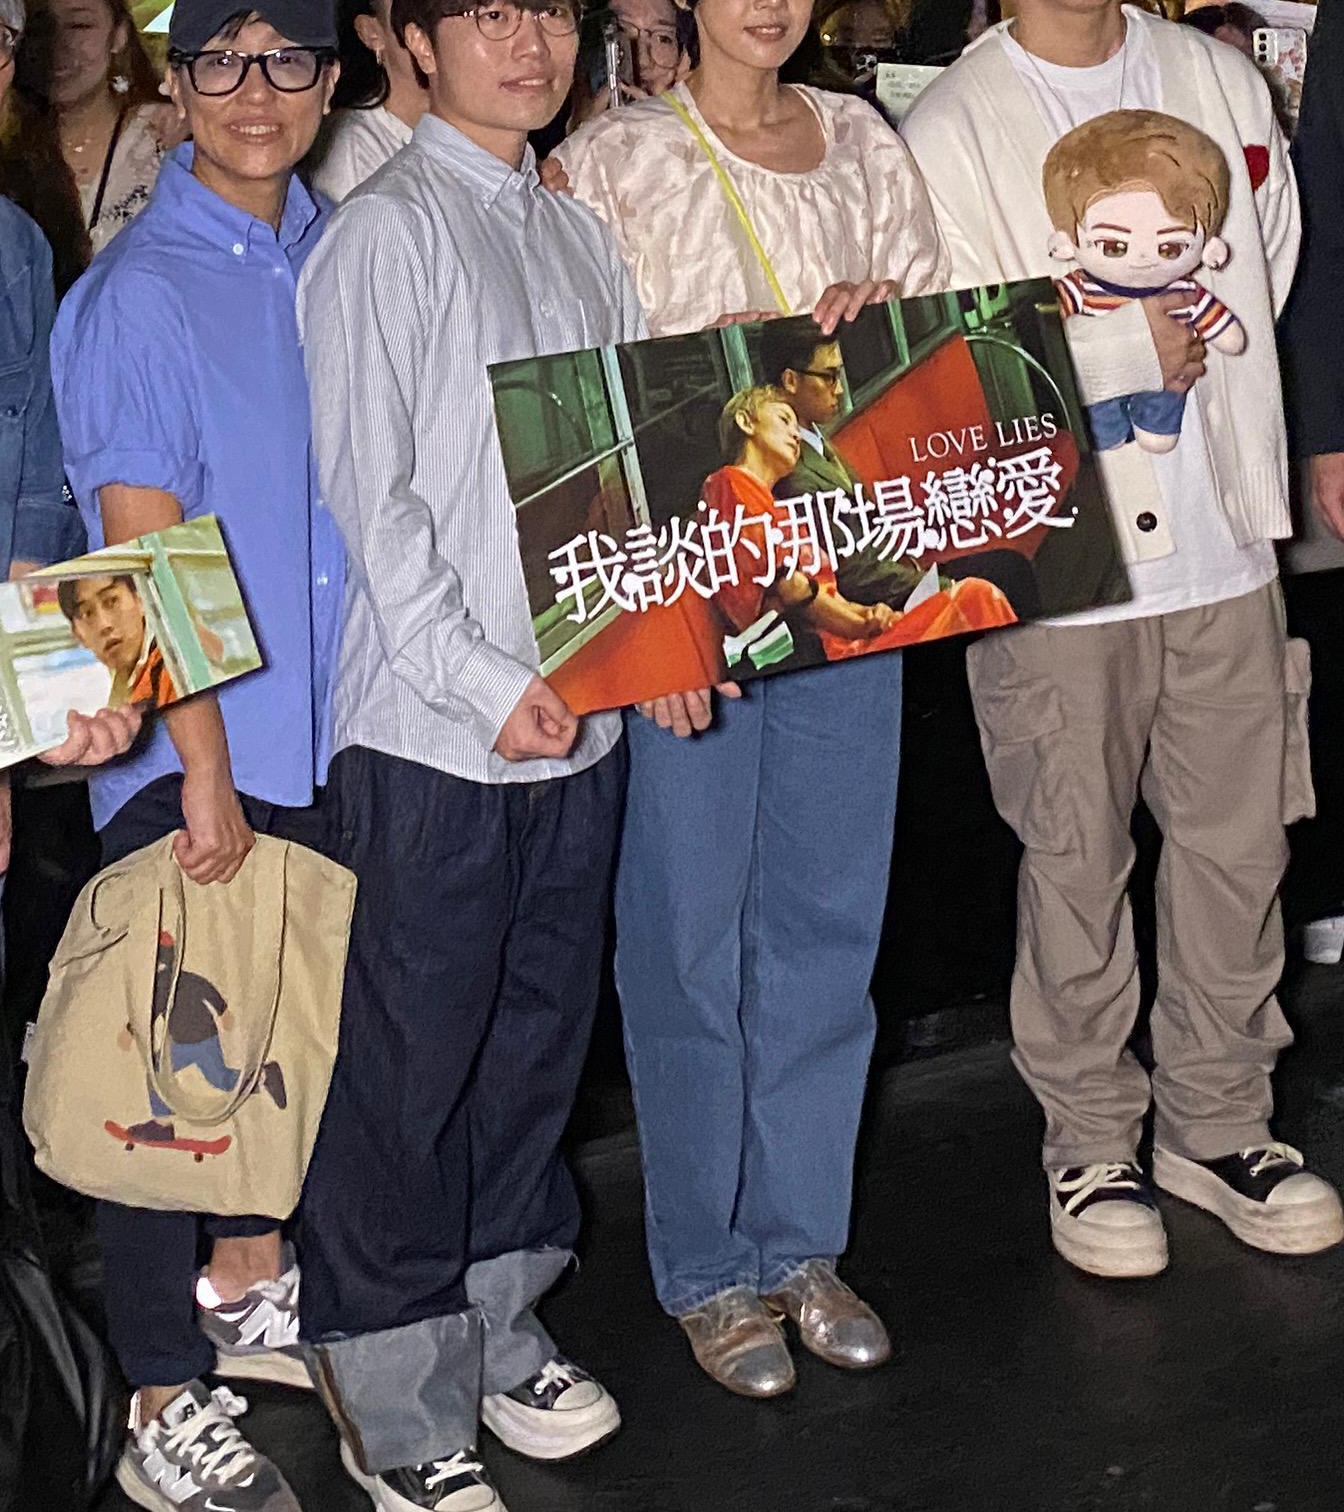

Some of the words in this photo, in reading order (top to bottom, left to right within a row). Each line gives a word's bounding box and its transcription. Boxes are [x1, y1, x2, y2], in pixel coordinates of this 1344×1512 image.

[910, 422, 987, 465] LOVE
[994, 412, 1058, 452] LIES
[548, 445, 1080, 626] 我談的那場戀愛
